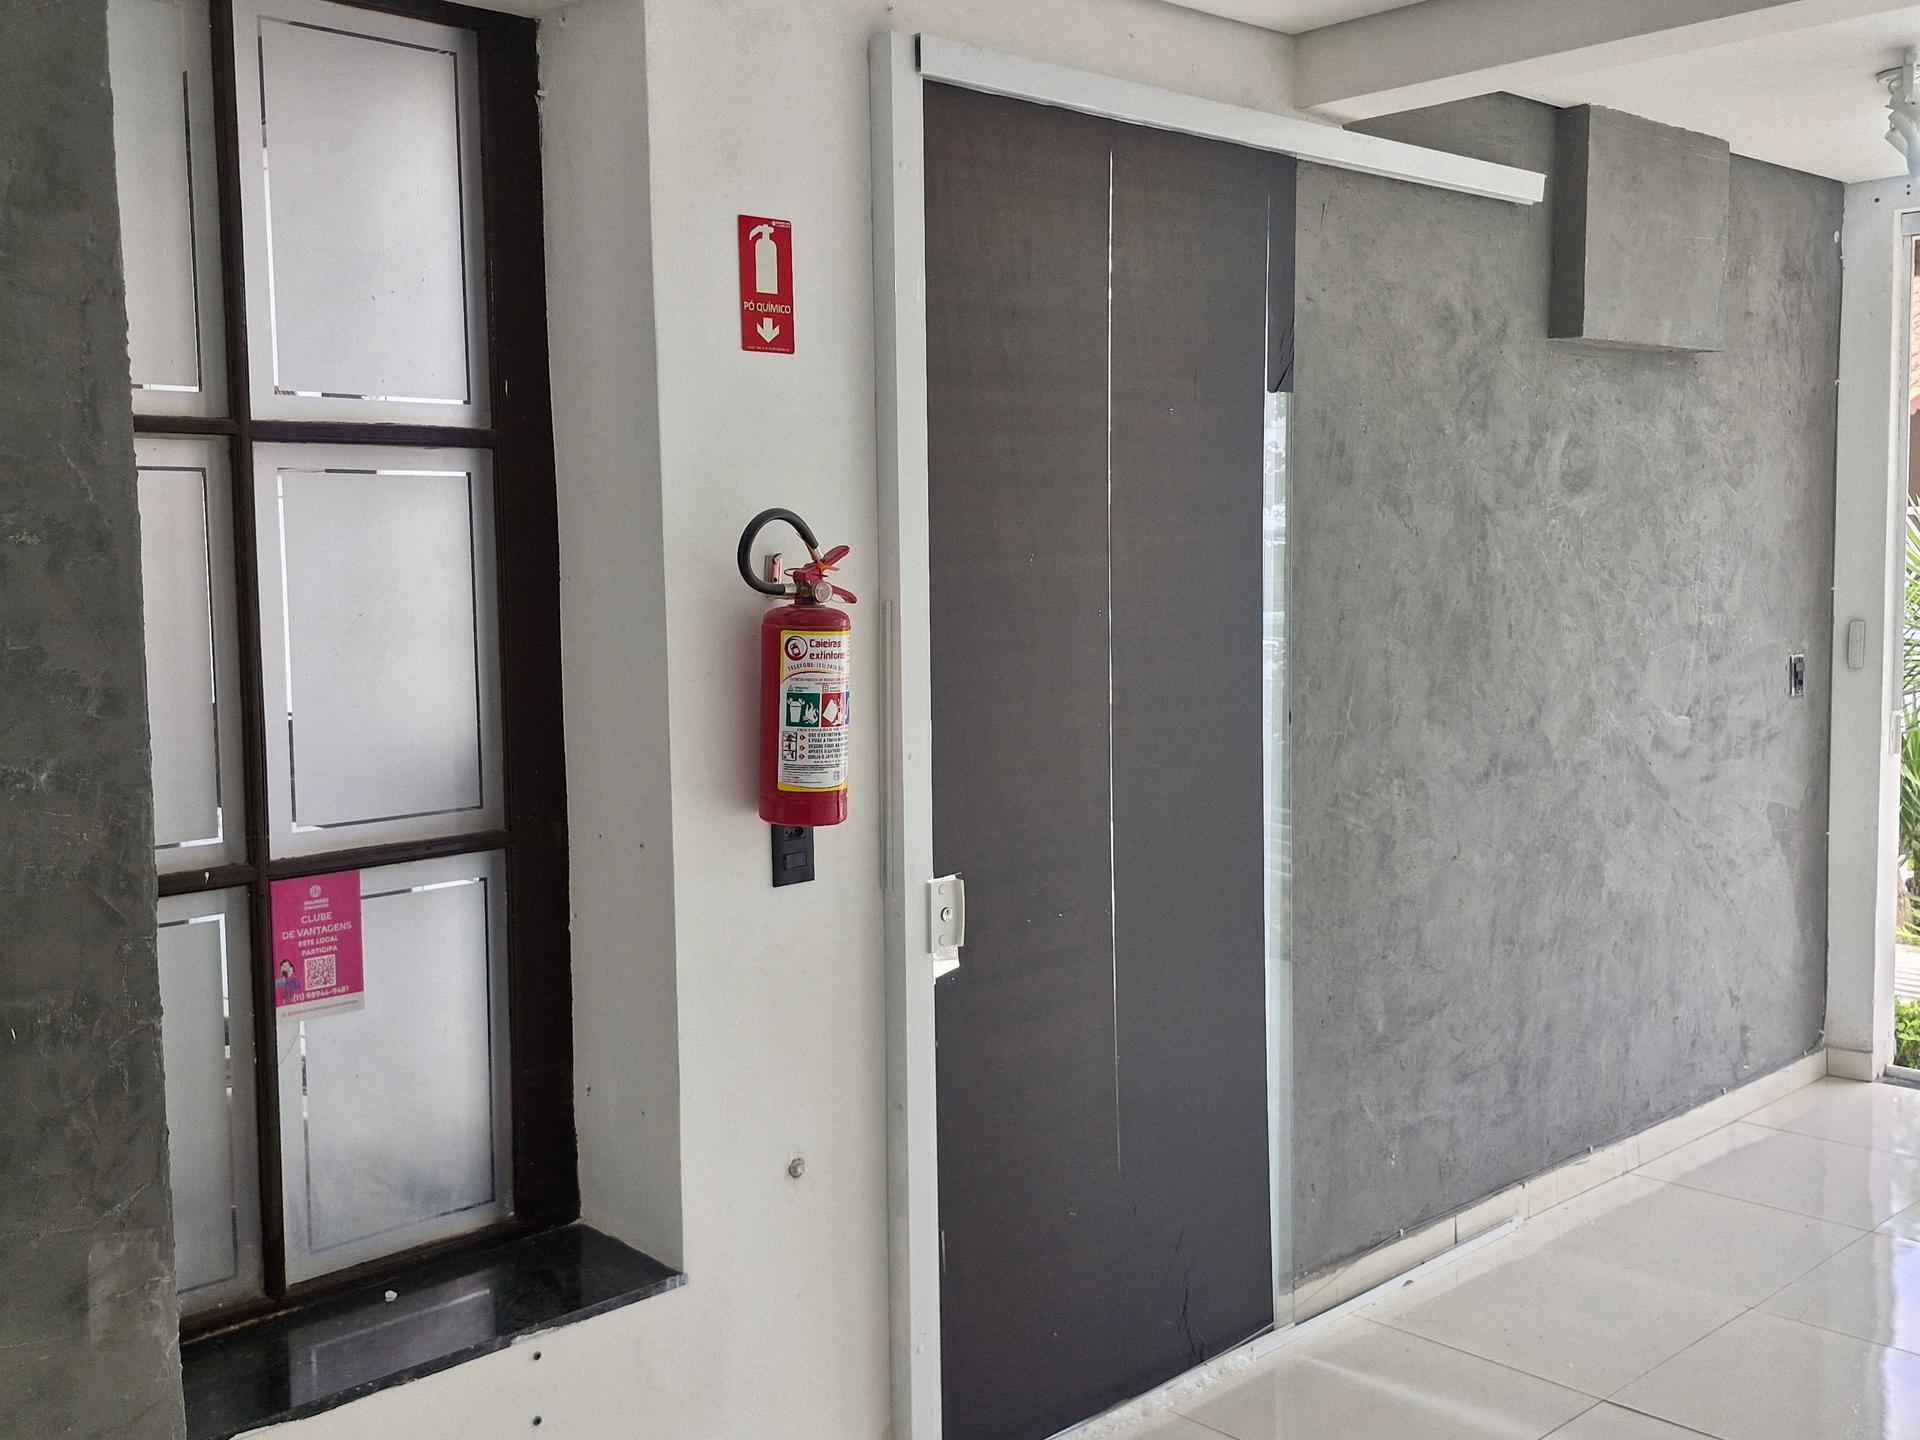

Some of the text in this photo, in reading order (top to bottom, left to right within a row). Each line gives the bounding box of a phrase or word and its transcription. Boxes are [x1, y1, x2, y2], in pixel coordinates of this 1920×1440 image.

[744, 299, 792, 314] PÓ QUÍMICO
[809, 638, 842, 648] Caieiras
[300, 912, 333, 924] CLUBE
[282, 921, 353, 940] DE VANTAGENS
[298, 935, 338, 948] ESTE LOCAL
[301, 945, 338, 957] PARTICIPA
